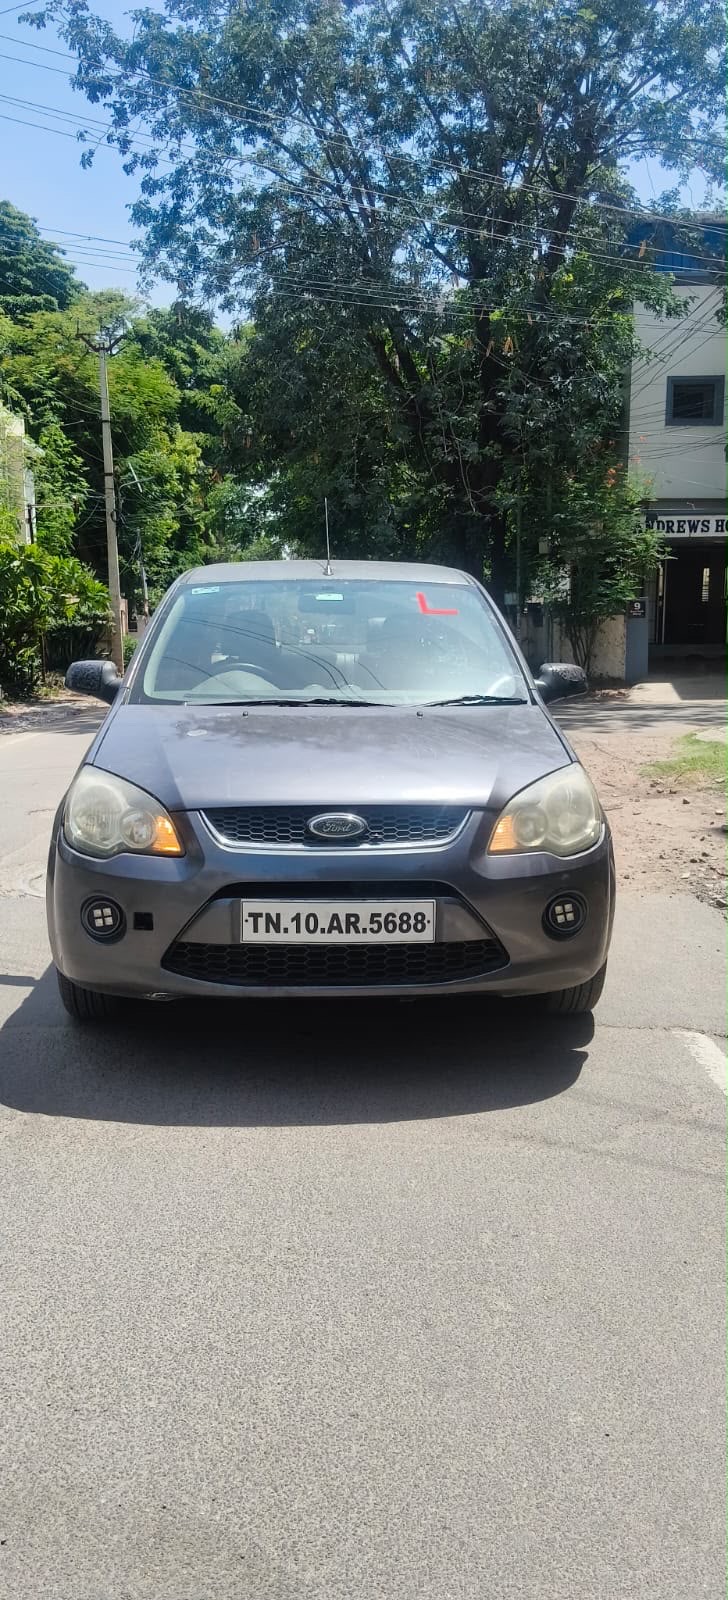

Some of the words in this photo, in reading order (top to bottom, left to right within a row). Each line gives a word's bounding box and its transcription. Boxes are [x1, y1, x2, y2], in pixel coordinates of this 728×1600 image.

[714, 519, 728, 533] H
[634, 602, 641, 610] 9
[318, 819, 351, 832] Ford
[247, 911, 427, 935] TN.10.AR.5688
